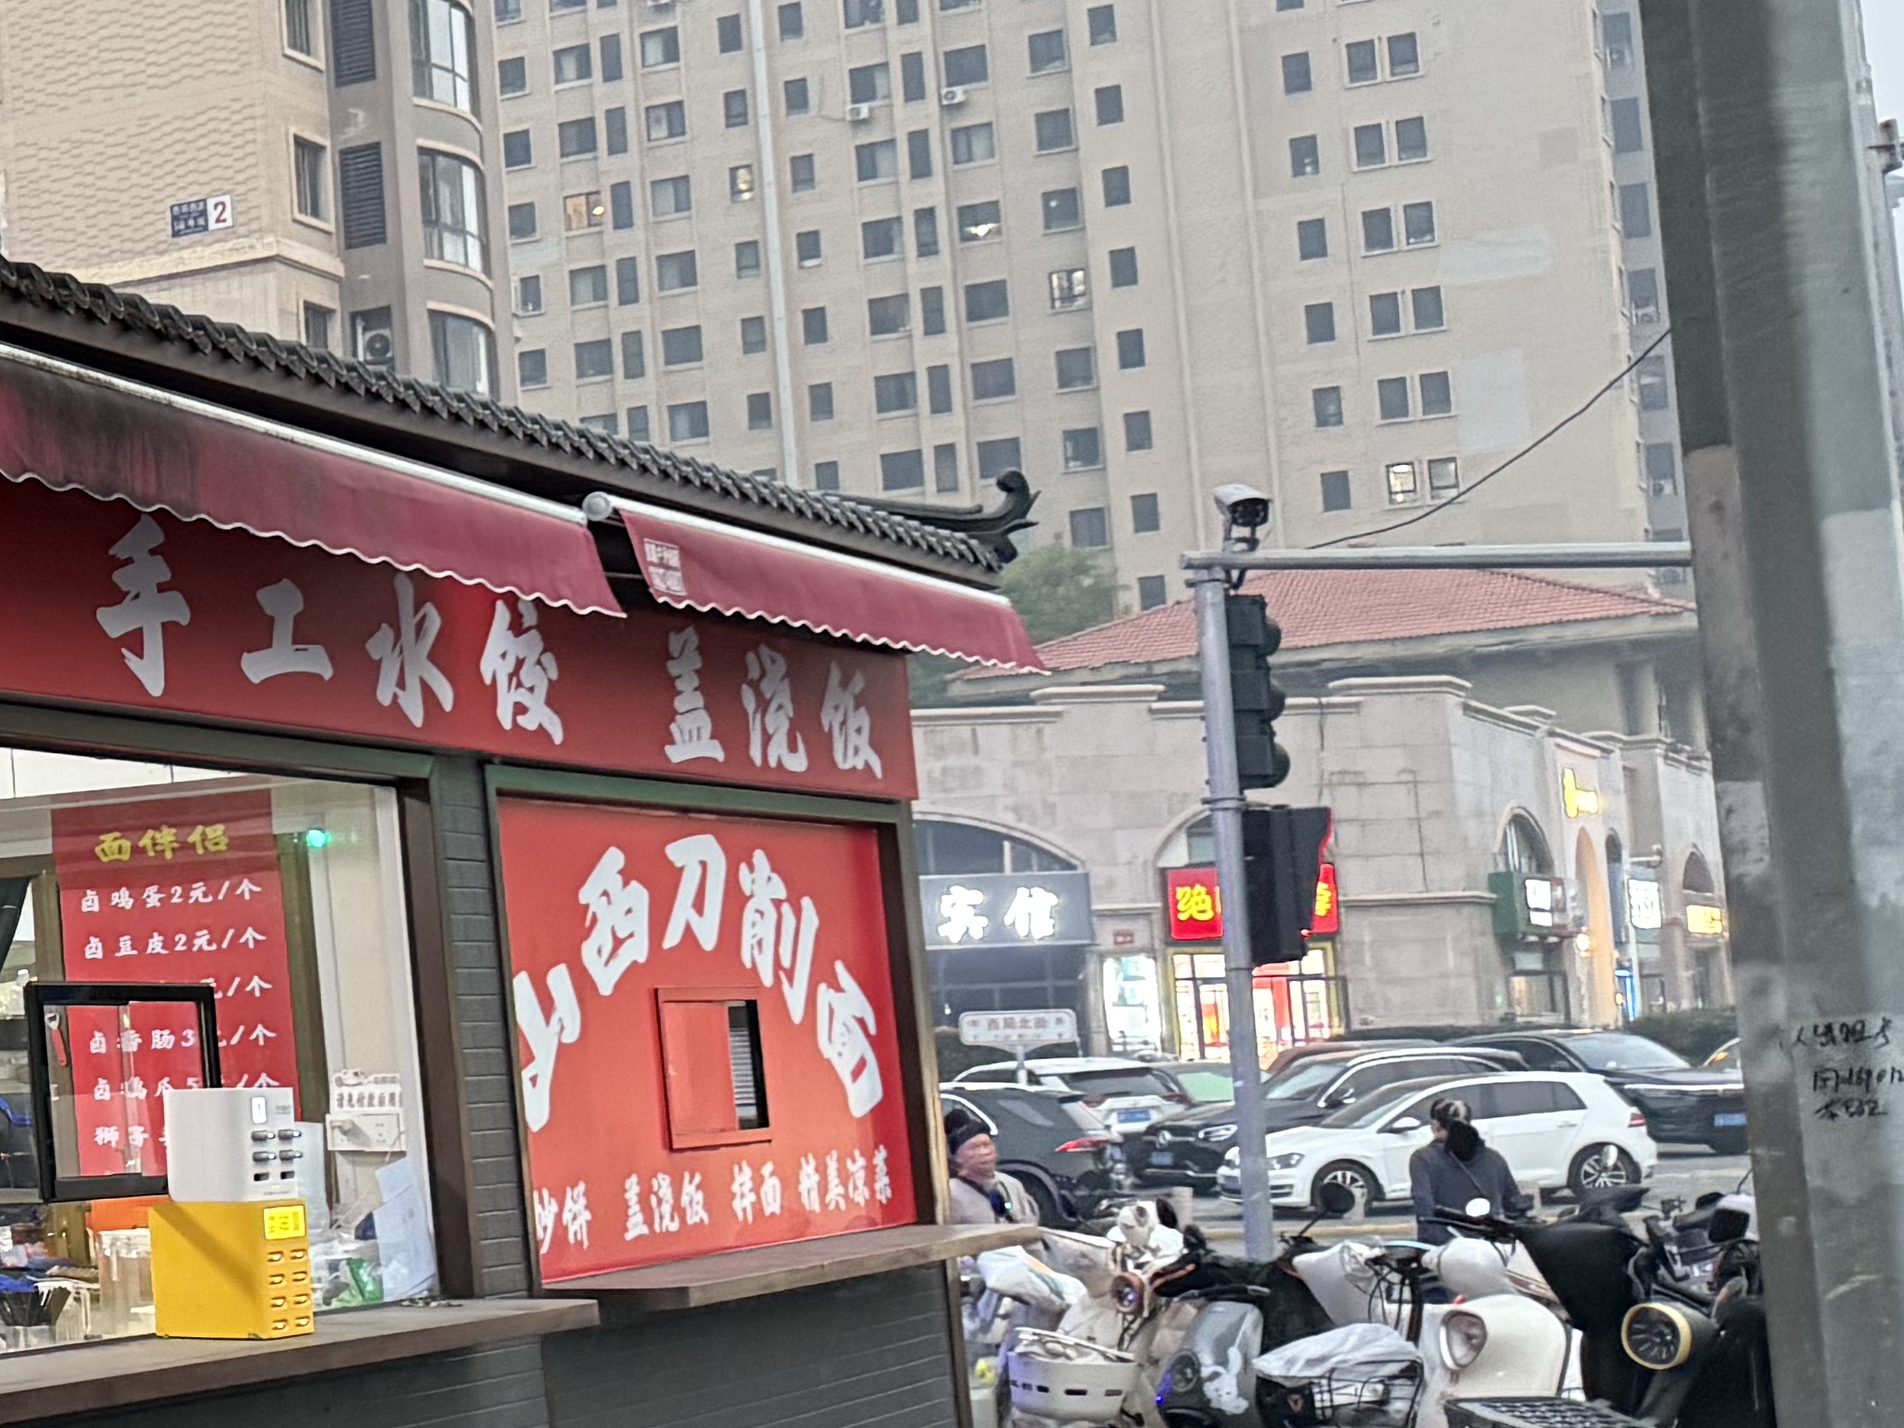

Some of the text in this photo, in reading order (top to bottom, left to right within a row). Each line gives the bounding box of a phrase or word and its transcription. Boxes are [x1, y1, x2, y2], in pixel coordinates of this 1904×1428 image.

[214, 201, 227, 224] 2
[97, 515, 563, 745] 手工水饺
[664, 627, 883, 780] 盖浇饭
[94, 824, 229, 863] 面伴侣
[81, 878, 262, 912] 卤鸡蛋2元/个
[85, 927, 266, 959] 卤豆皮2元/个
[513, 834, 883, 1132] 山西刀削面
[90, 1024, 277, 1054] 卤香肠3/个
[94, 1126, 167, 1147] 狮子
[533, 1145, 892, 1254] 炒饼 盖浇饭 拌面 精美凉菜
